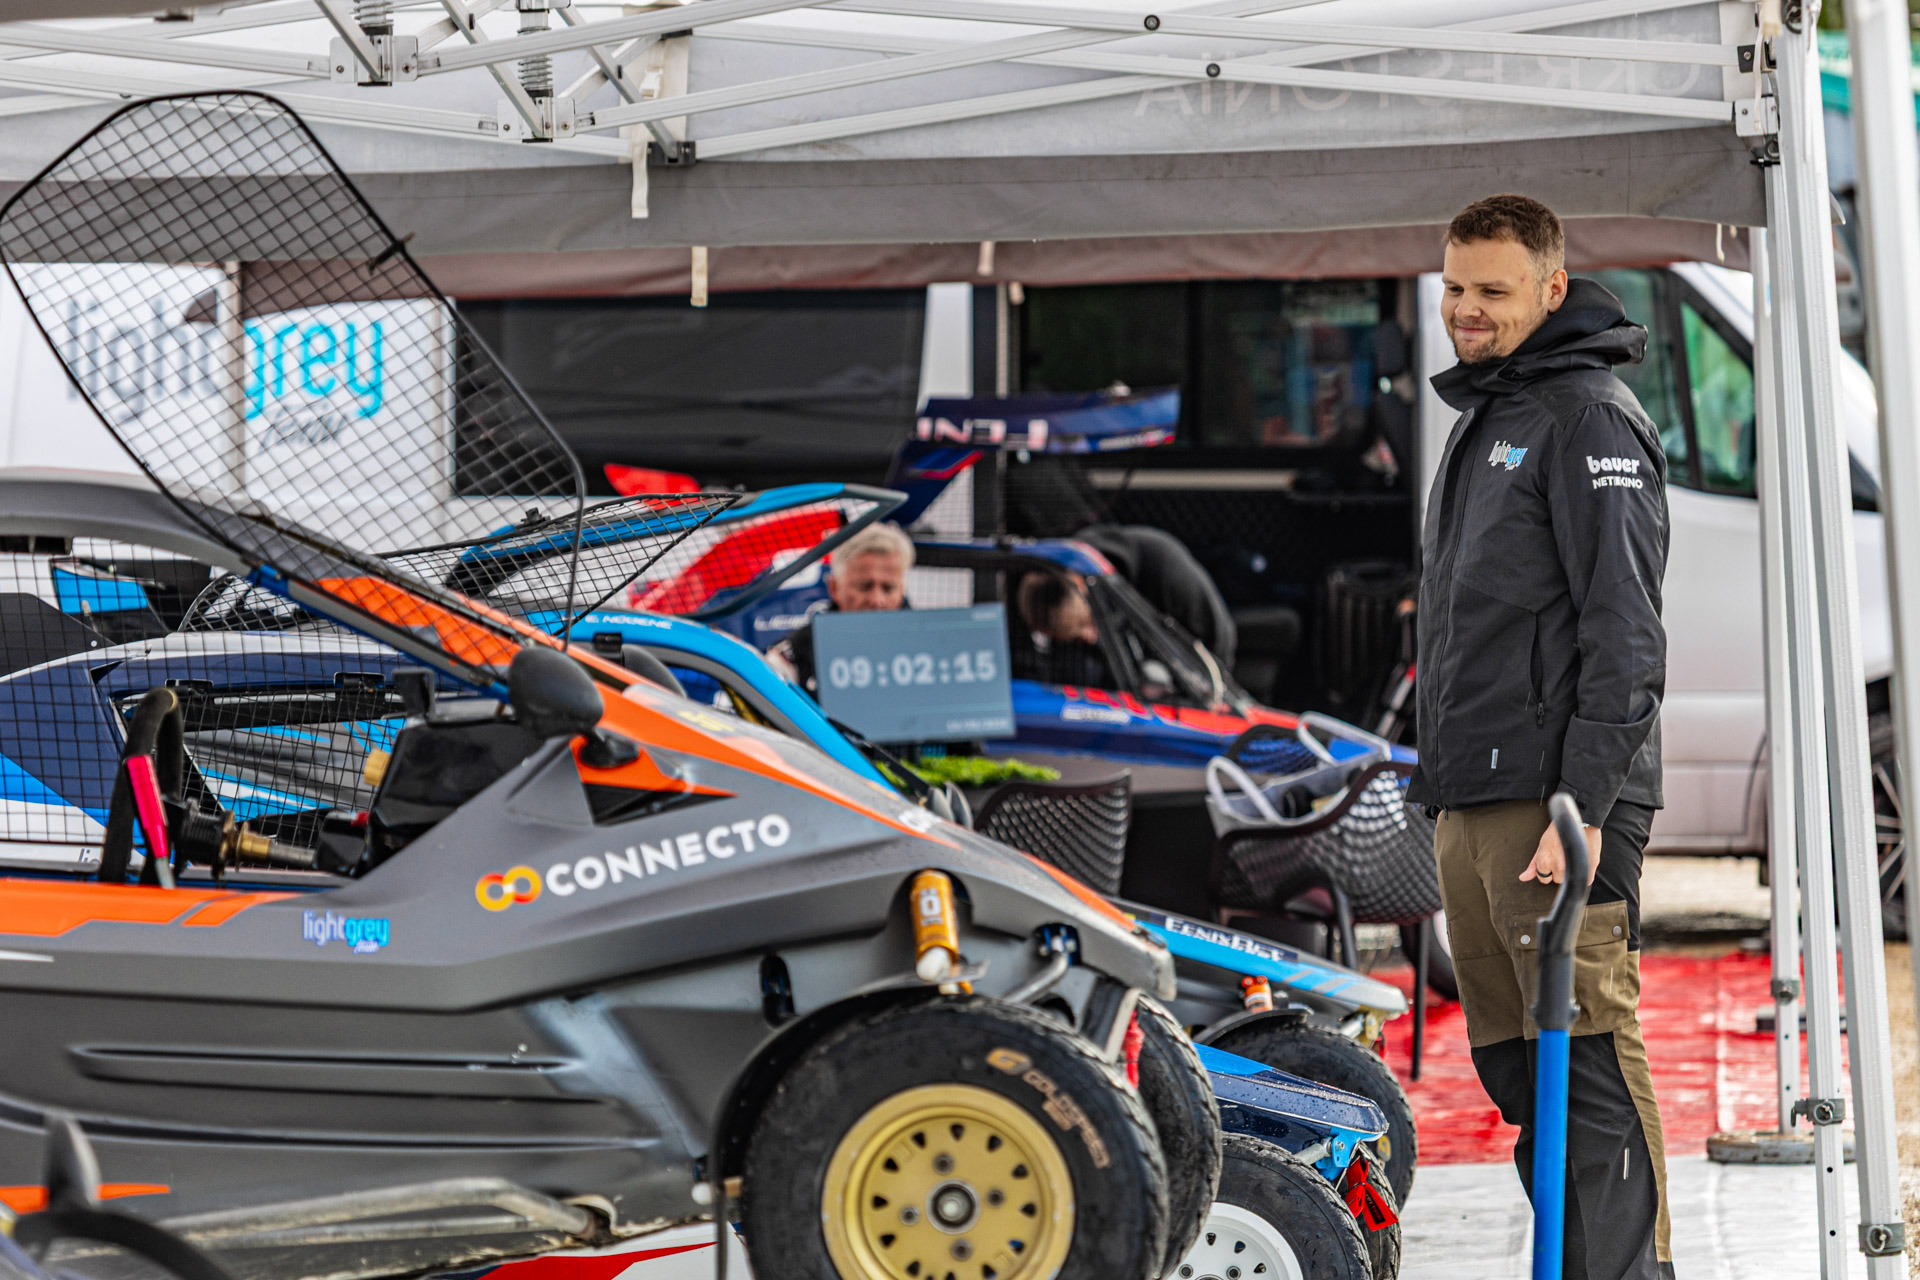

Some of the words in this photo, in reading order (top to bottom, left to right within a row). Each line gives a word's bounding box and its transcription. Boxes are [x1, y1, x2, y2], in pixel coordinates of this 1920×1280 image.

[1488, 440, 1528, 467] lightgrey
[1586, 455, 1640, 474] bauer
[829, 651, 997, 690] 09:02:15
[546, 813, 791, 896] CONNECTO
[303, 908, 389, 947] lightgrey
